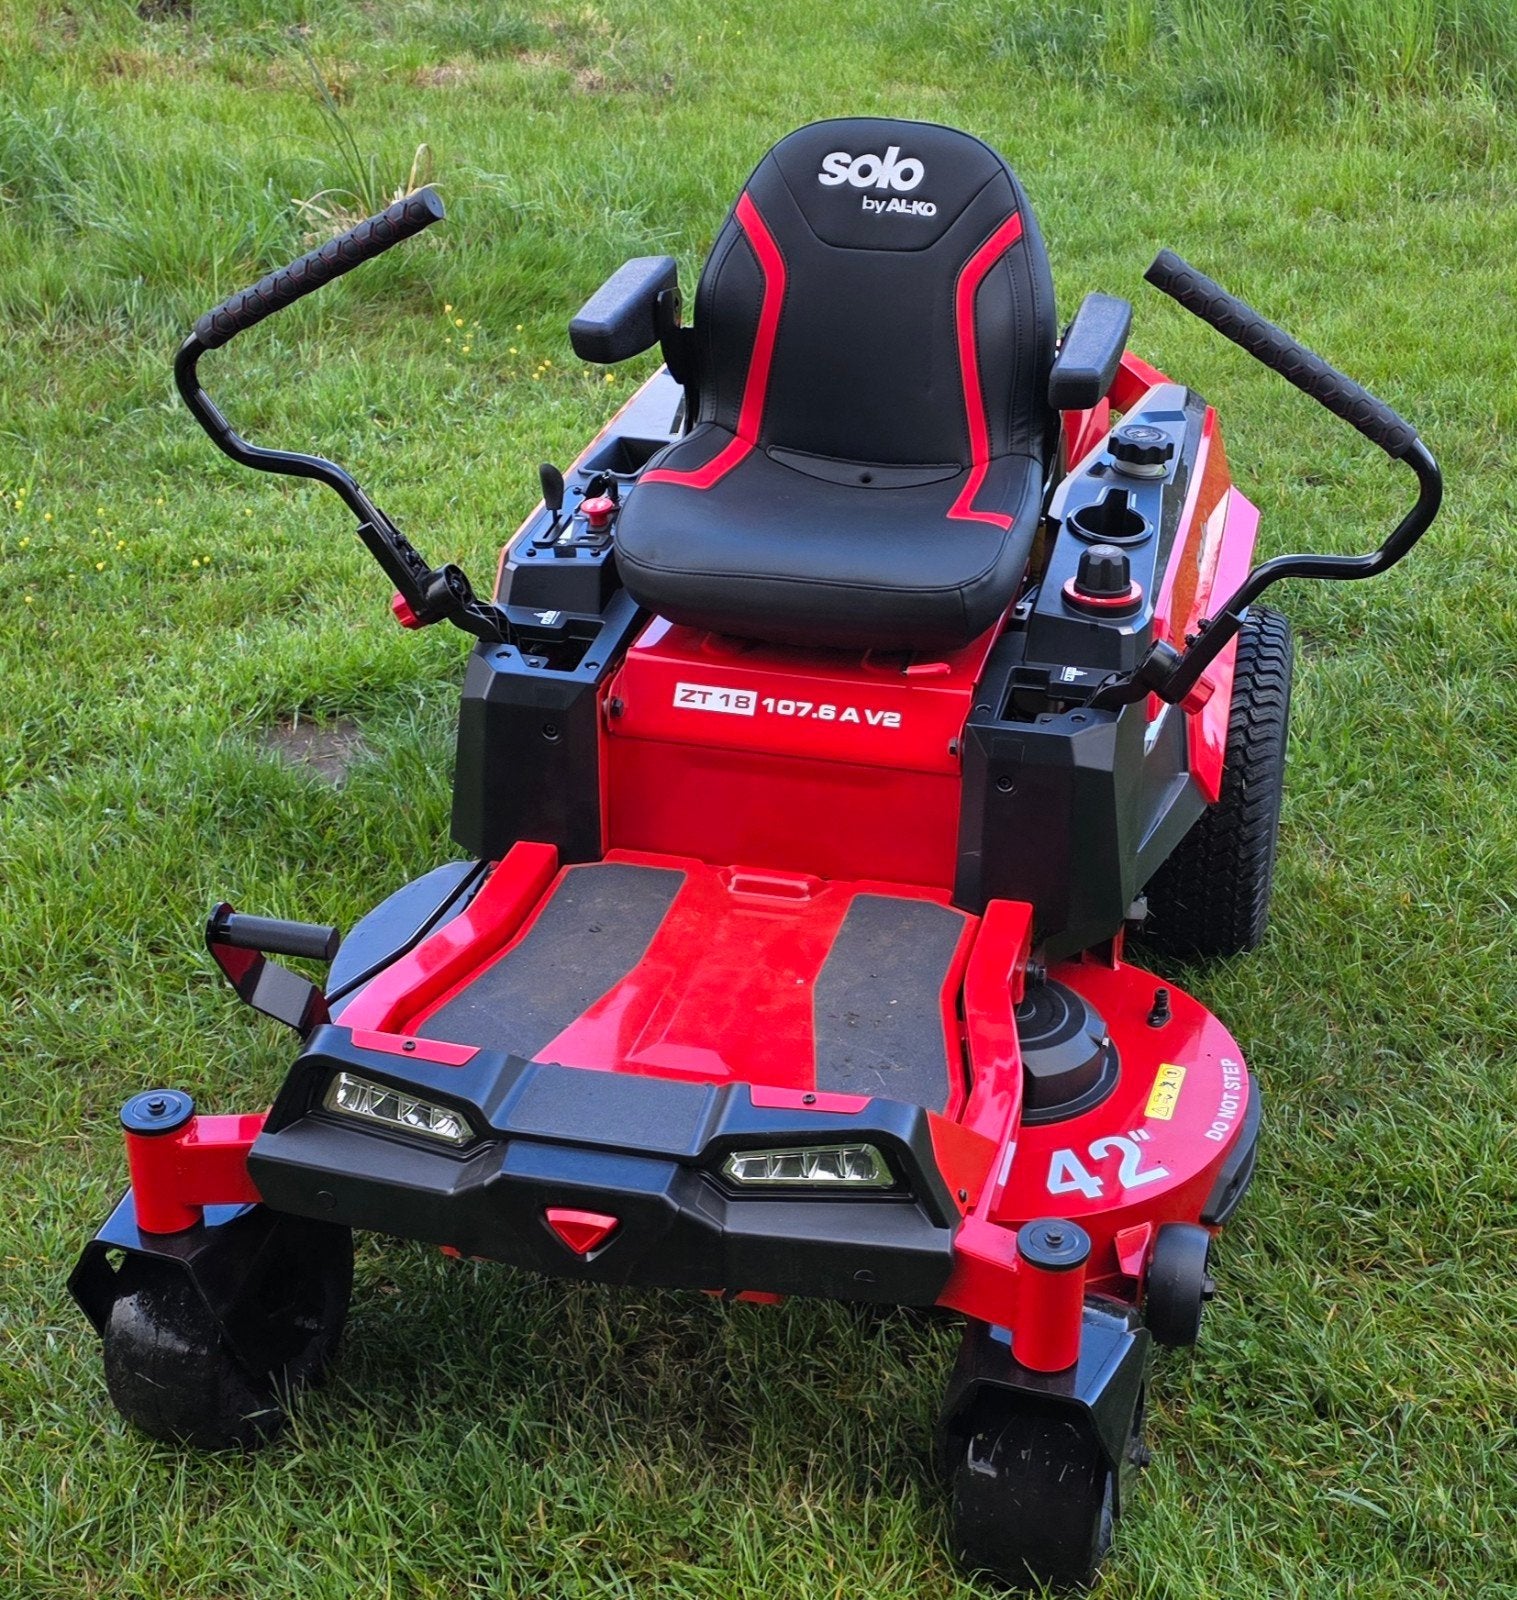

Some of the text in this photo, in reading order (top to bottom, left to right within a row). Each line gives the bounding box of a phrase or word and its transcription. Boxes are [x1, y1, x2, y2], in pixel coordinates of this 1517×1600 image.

[818, 145, 925, 192] solo
[862, 195, 937, 217] by AL-KO
[680, 688, 901, 729] ZT 18 107.6 A V2
[1204, 1058, 1241, 1142] DO NOT STEP
